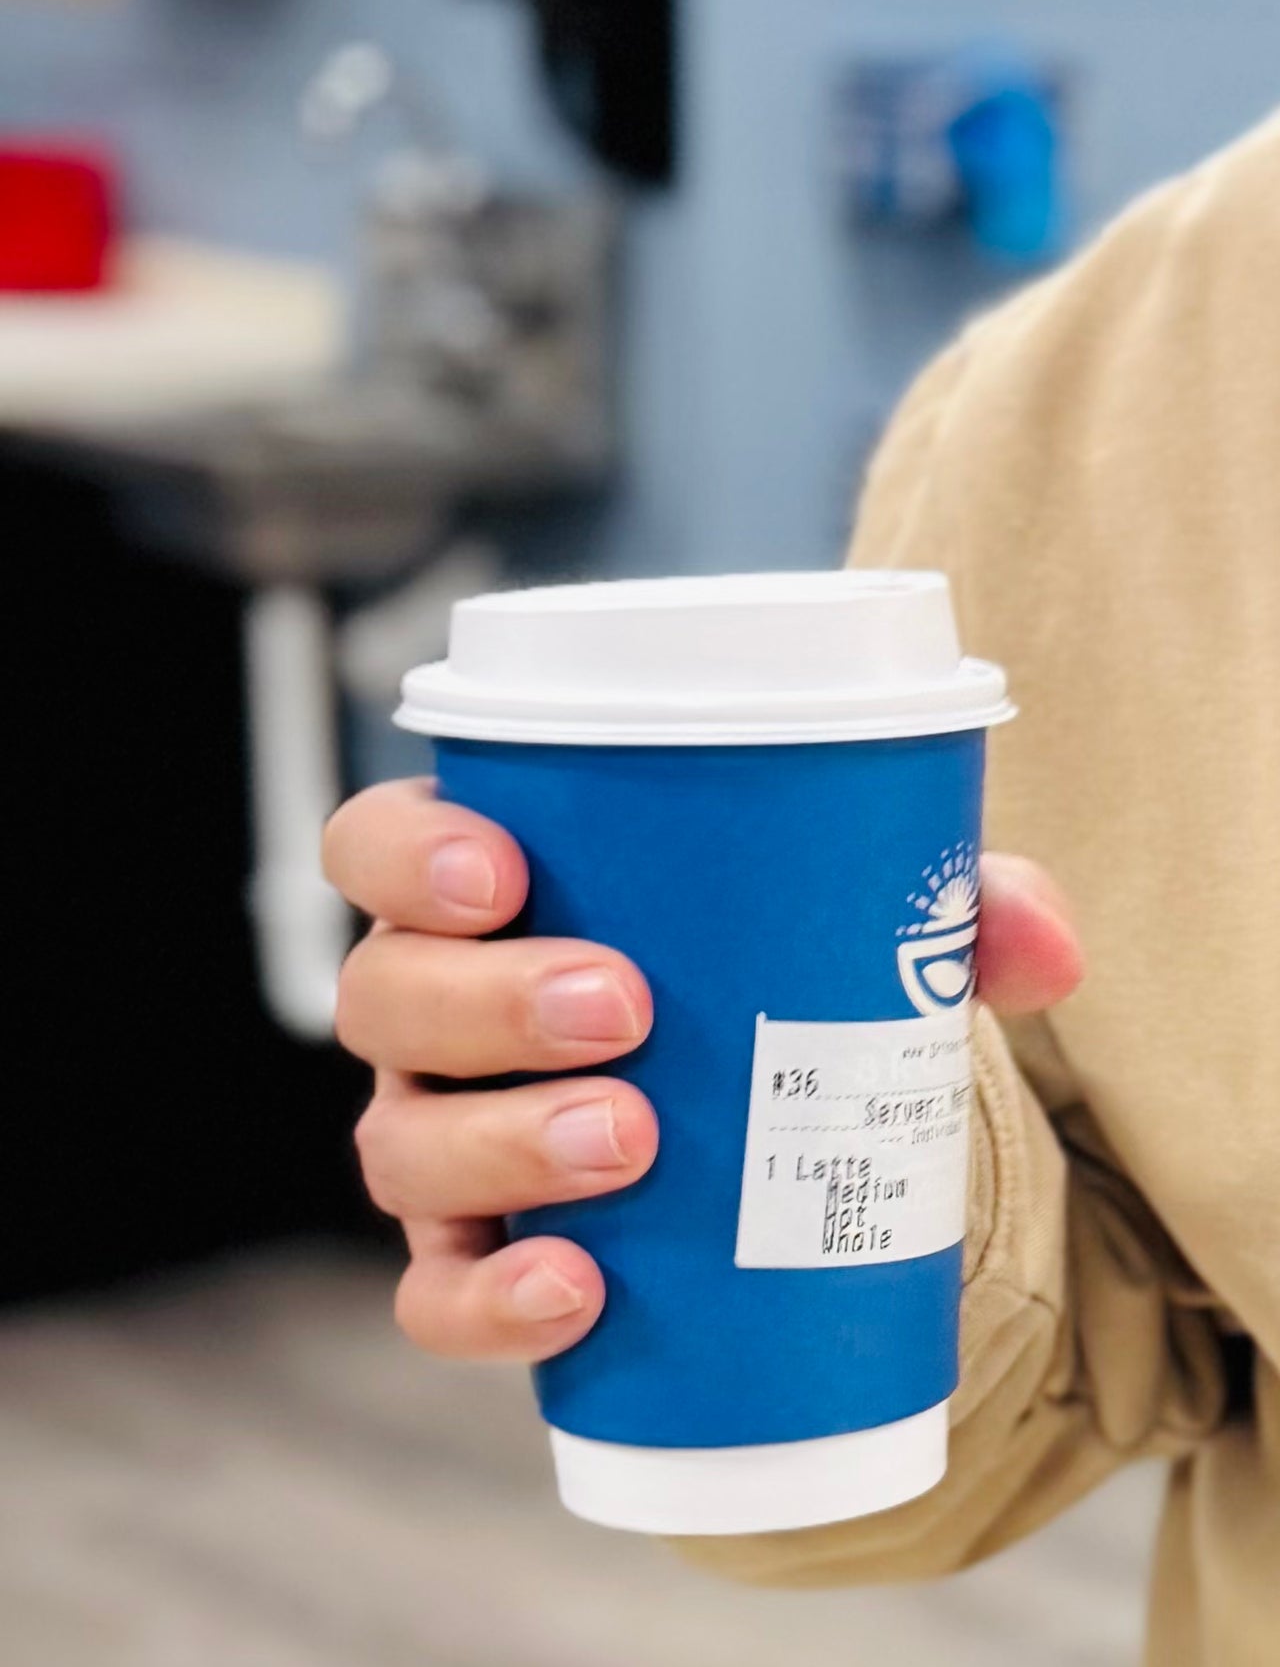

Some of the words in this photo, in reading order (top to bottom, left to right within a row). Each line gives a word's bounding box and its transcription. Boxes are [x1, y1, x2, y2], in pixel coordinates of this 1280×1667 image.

[772, 1068, 819, 1097] #36
[796, 1153, 872, 1181] Latte
[822, 1225, 893, 1254] Whole
